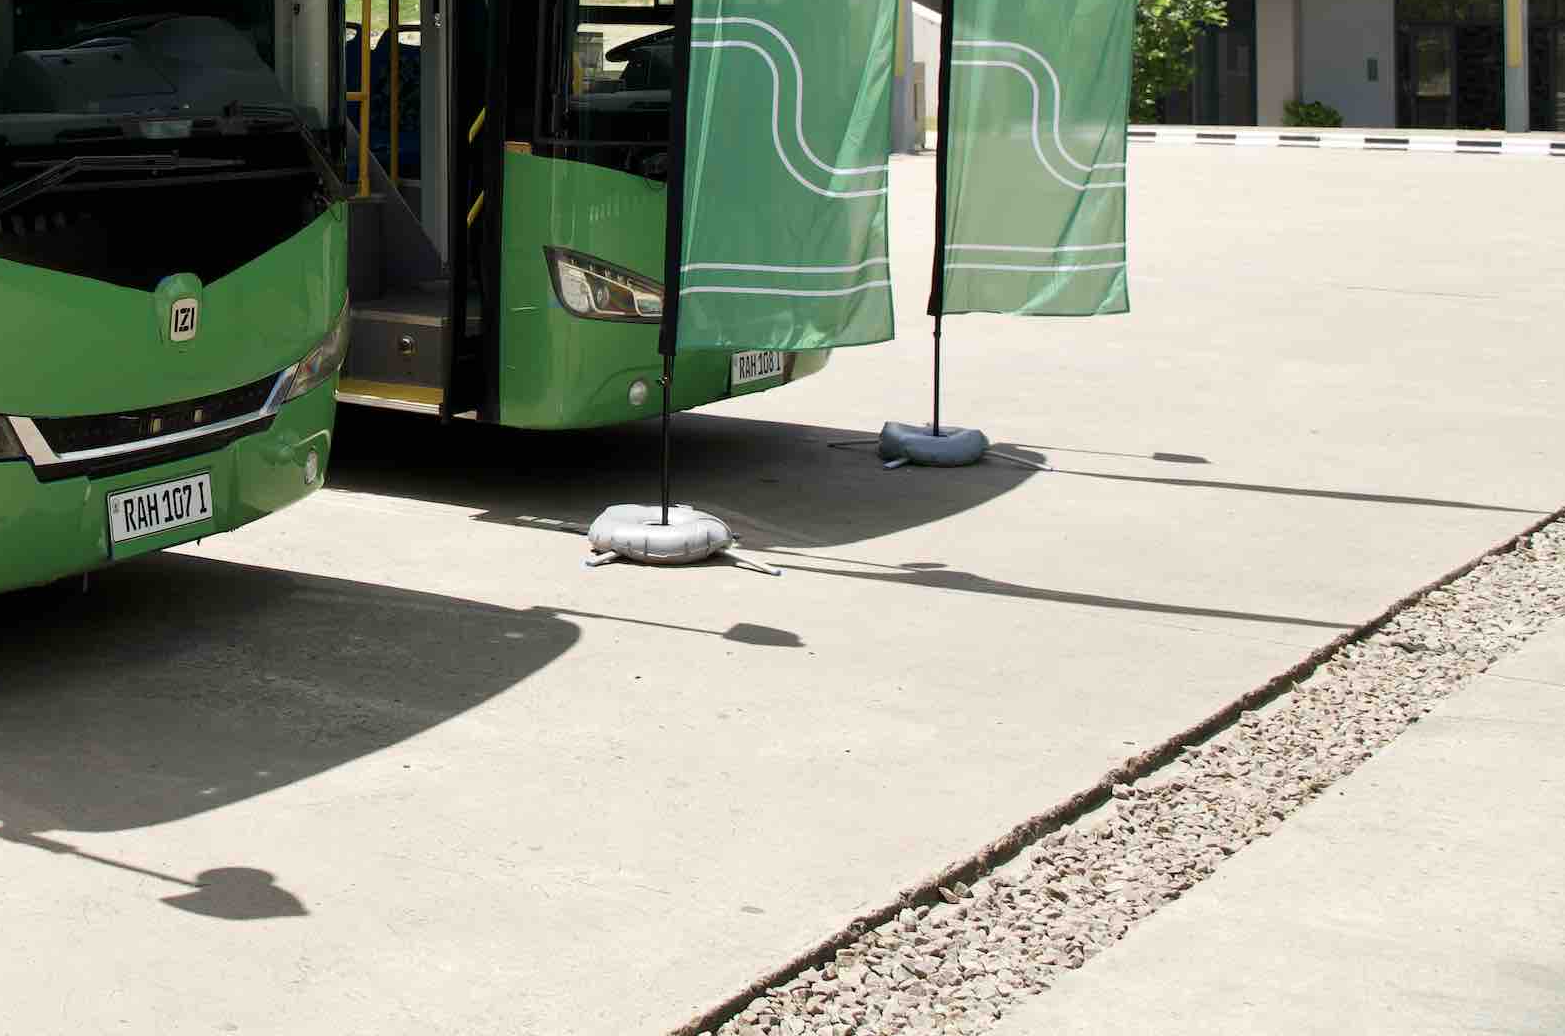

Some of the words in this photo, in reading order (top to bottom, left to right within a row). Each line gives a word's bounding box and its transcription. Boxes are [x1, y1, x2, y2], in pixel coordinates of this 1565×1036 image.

[174, 307, 195, 332] IZI
[739, 355, 756, 380] RAH
[124, 496, 160, 532] RAH
[163, 484, 192, 523] 107
